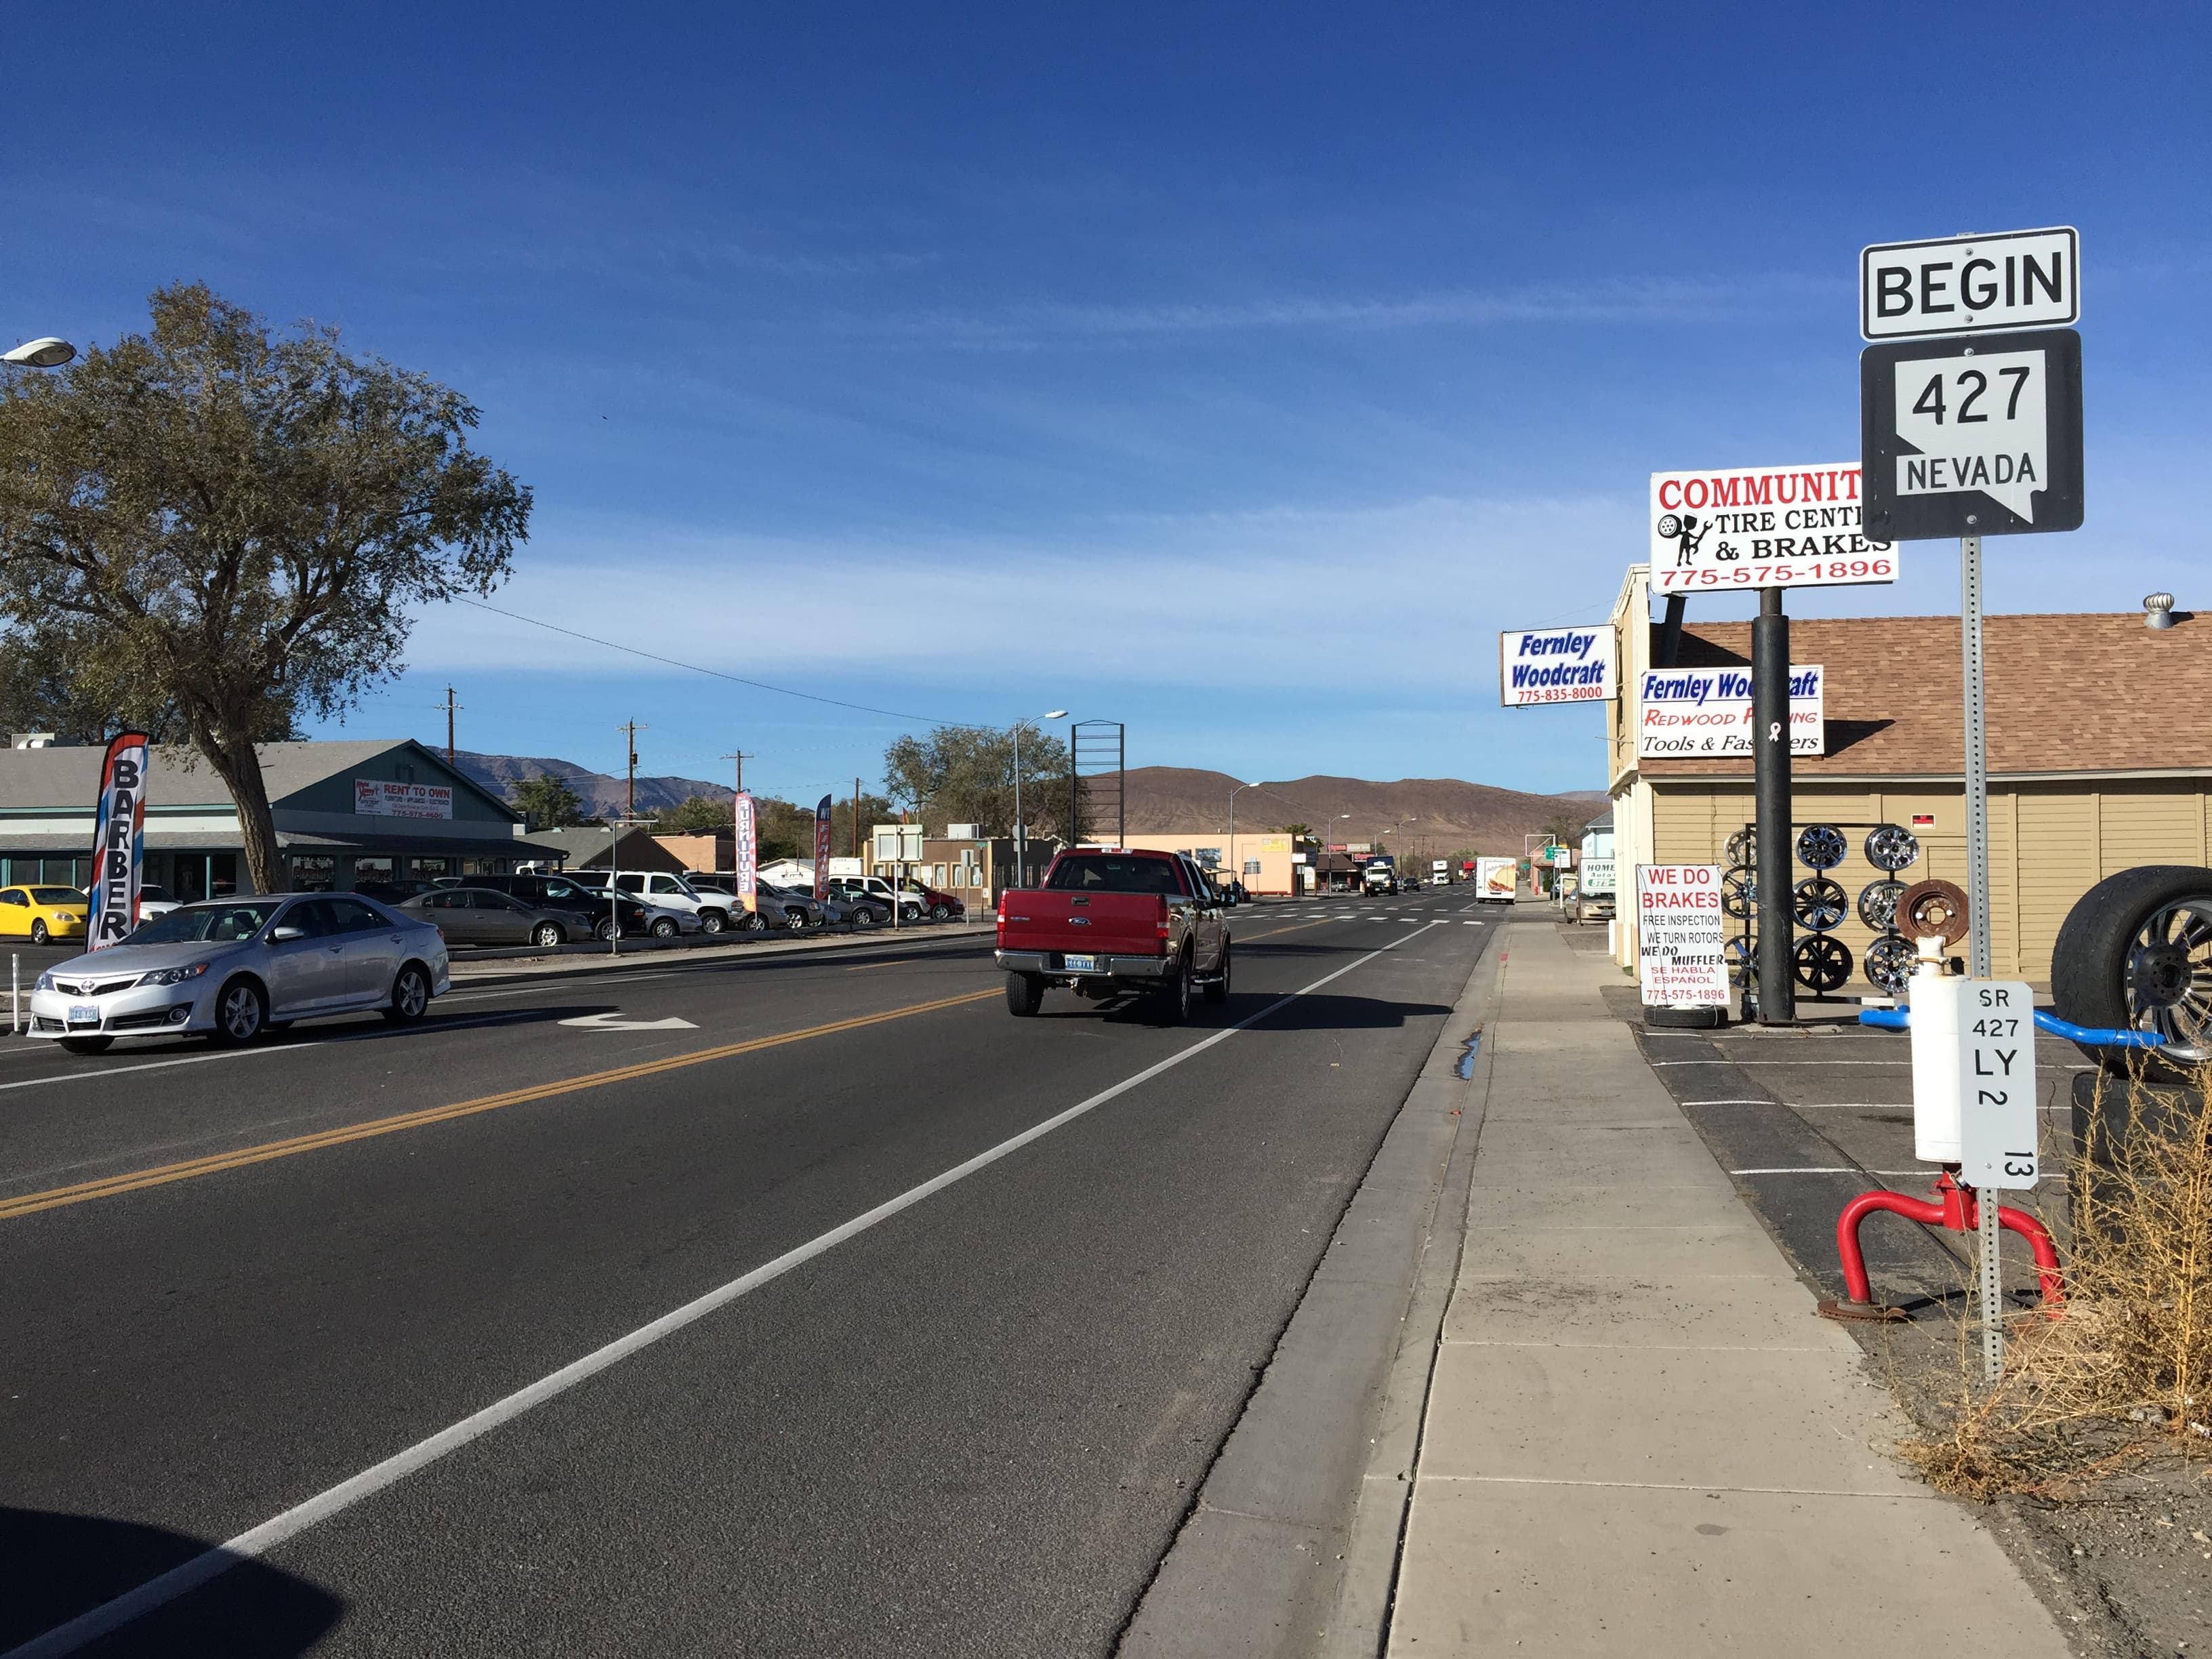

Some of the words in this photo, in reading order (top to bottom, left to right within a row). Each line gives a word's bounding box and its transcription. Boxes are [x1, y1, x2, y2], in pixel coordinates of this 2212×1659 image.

[1877, 251, 2062, 317] BEGIN
[1912, 367, 2030, 425] 427
[1907, 453, 2036, 489] NEVADA
[1659, 469, 1862, 510] COMMUNIT
[1715, 512, 1776, 533] TIRE
[1785, 506, 1862, 530] CENT
[1715, 541, 1739, 560] &
[1660, 560, 1891, 586] 775-575-1896
[1519, 632, 1597, 660] Fernley
[1512, 659, 1605, 688] Woodcraft
[1518, 687, 1602, 702] 775-835-8000
[1643, 674, 1713, 706] Fernley
[1644, 709, 1736, 726] REDWOOD
[1643, 736, 1694, 751] Tools
[1700, 737, 1715, 750] &
[384, 784, 410, 795] RENT
[413, 787, 426, 796] TO
[429, 788, 450, 798] OWN
[99, 760, 140, 940] BARBER
[1648, 869, 1677, 884] WE
[1683, 869, 1710, 884] DO
[1642, 892, 1719, 908] BRAKES
[1643, 915, 1665, 926] FREE
[1668, 915, 1720, 926] INSPECTION
[1647, 932, 1660, 943] WE
[1663, 932, 1685, 943] TURN
[1689, 932, 1723, 943] ROTORS
[1641, 946, 1659, 956] WE
[1662, 945, 1678, 956] DO
[1672, 954, 1724, 965] MUFFLER
[1647, 989, 1725, 1000] 775-575-1896
[1980, 989, 2009, 1007] SR
[1973, 1019, 2018, 1037] 427
[1975, 1049, 2017, 1076] LY
[1979, 1090, 2008, 1105] 2
[2005, 1151, 2034, 1176] 13
